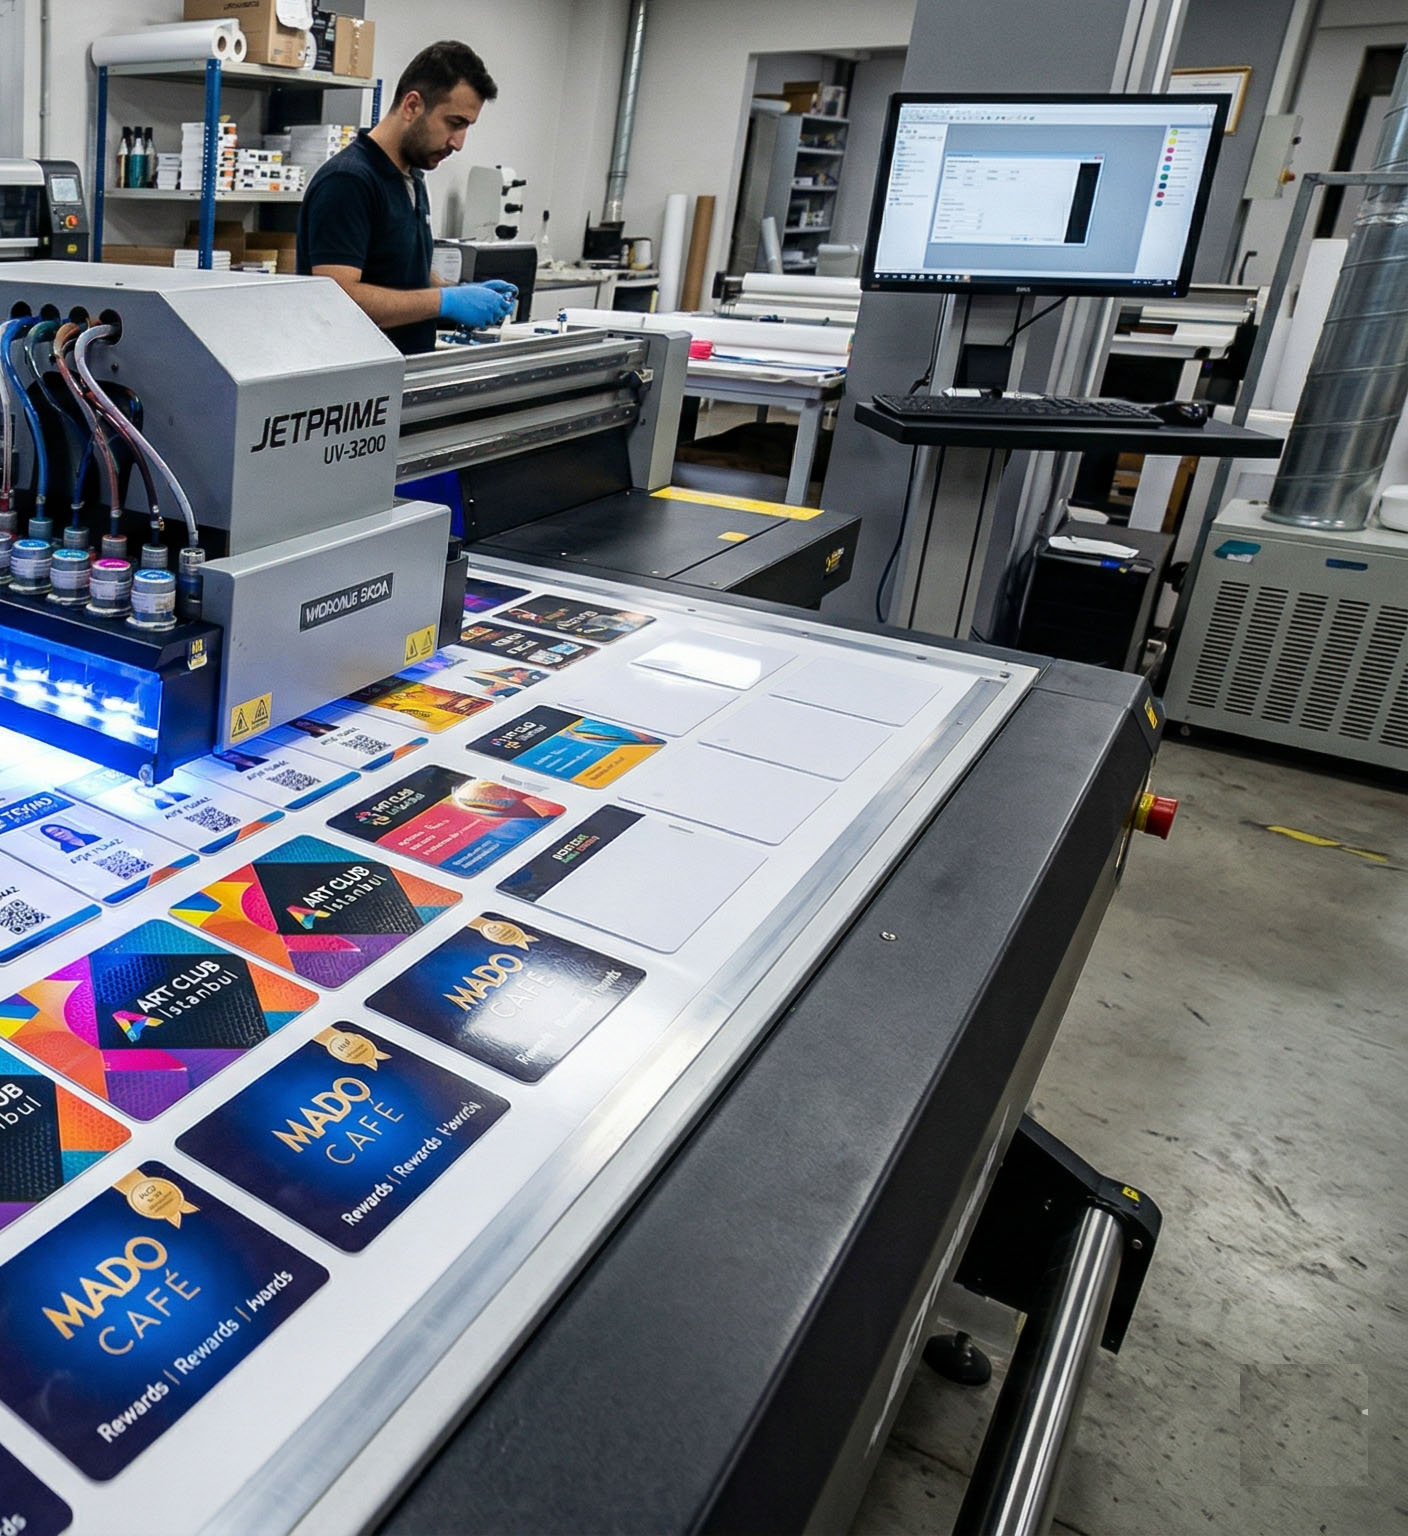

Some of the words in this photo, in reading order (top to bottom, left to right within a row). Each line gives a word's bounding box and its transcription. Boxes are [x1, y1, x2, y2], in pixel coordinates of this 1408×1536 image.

[251, 395, 390, 453] JETPRIME
[323, 434, 387, 465] UV-3200
[302, 884, 330, 909] ART
[328, 865, 371, 890] CLUB
[136, 983, 175, 1015] ART
[171, 959, 223, 992] CLUB
[156, 969, 240, 1020] Istanbul
[443, 952, 524, 1012] MADO
[271, 1076, 372, 1154] MADO
[340, 1181, 394, 1227] Rewards
[392, 1136, 443, 1178] Rewards
[41, 1236, 169, 1340] MADO
[98, 1269, 201, 1356] CAFÉ
[96, 1380, 170, 1444] Rewards
[173, 1315, 240, 1377] Rewards
